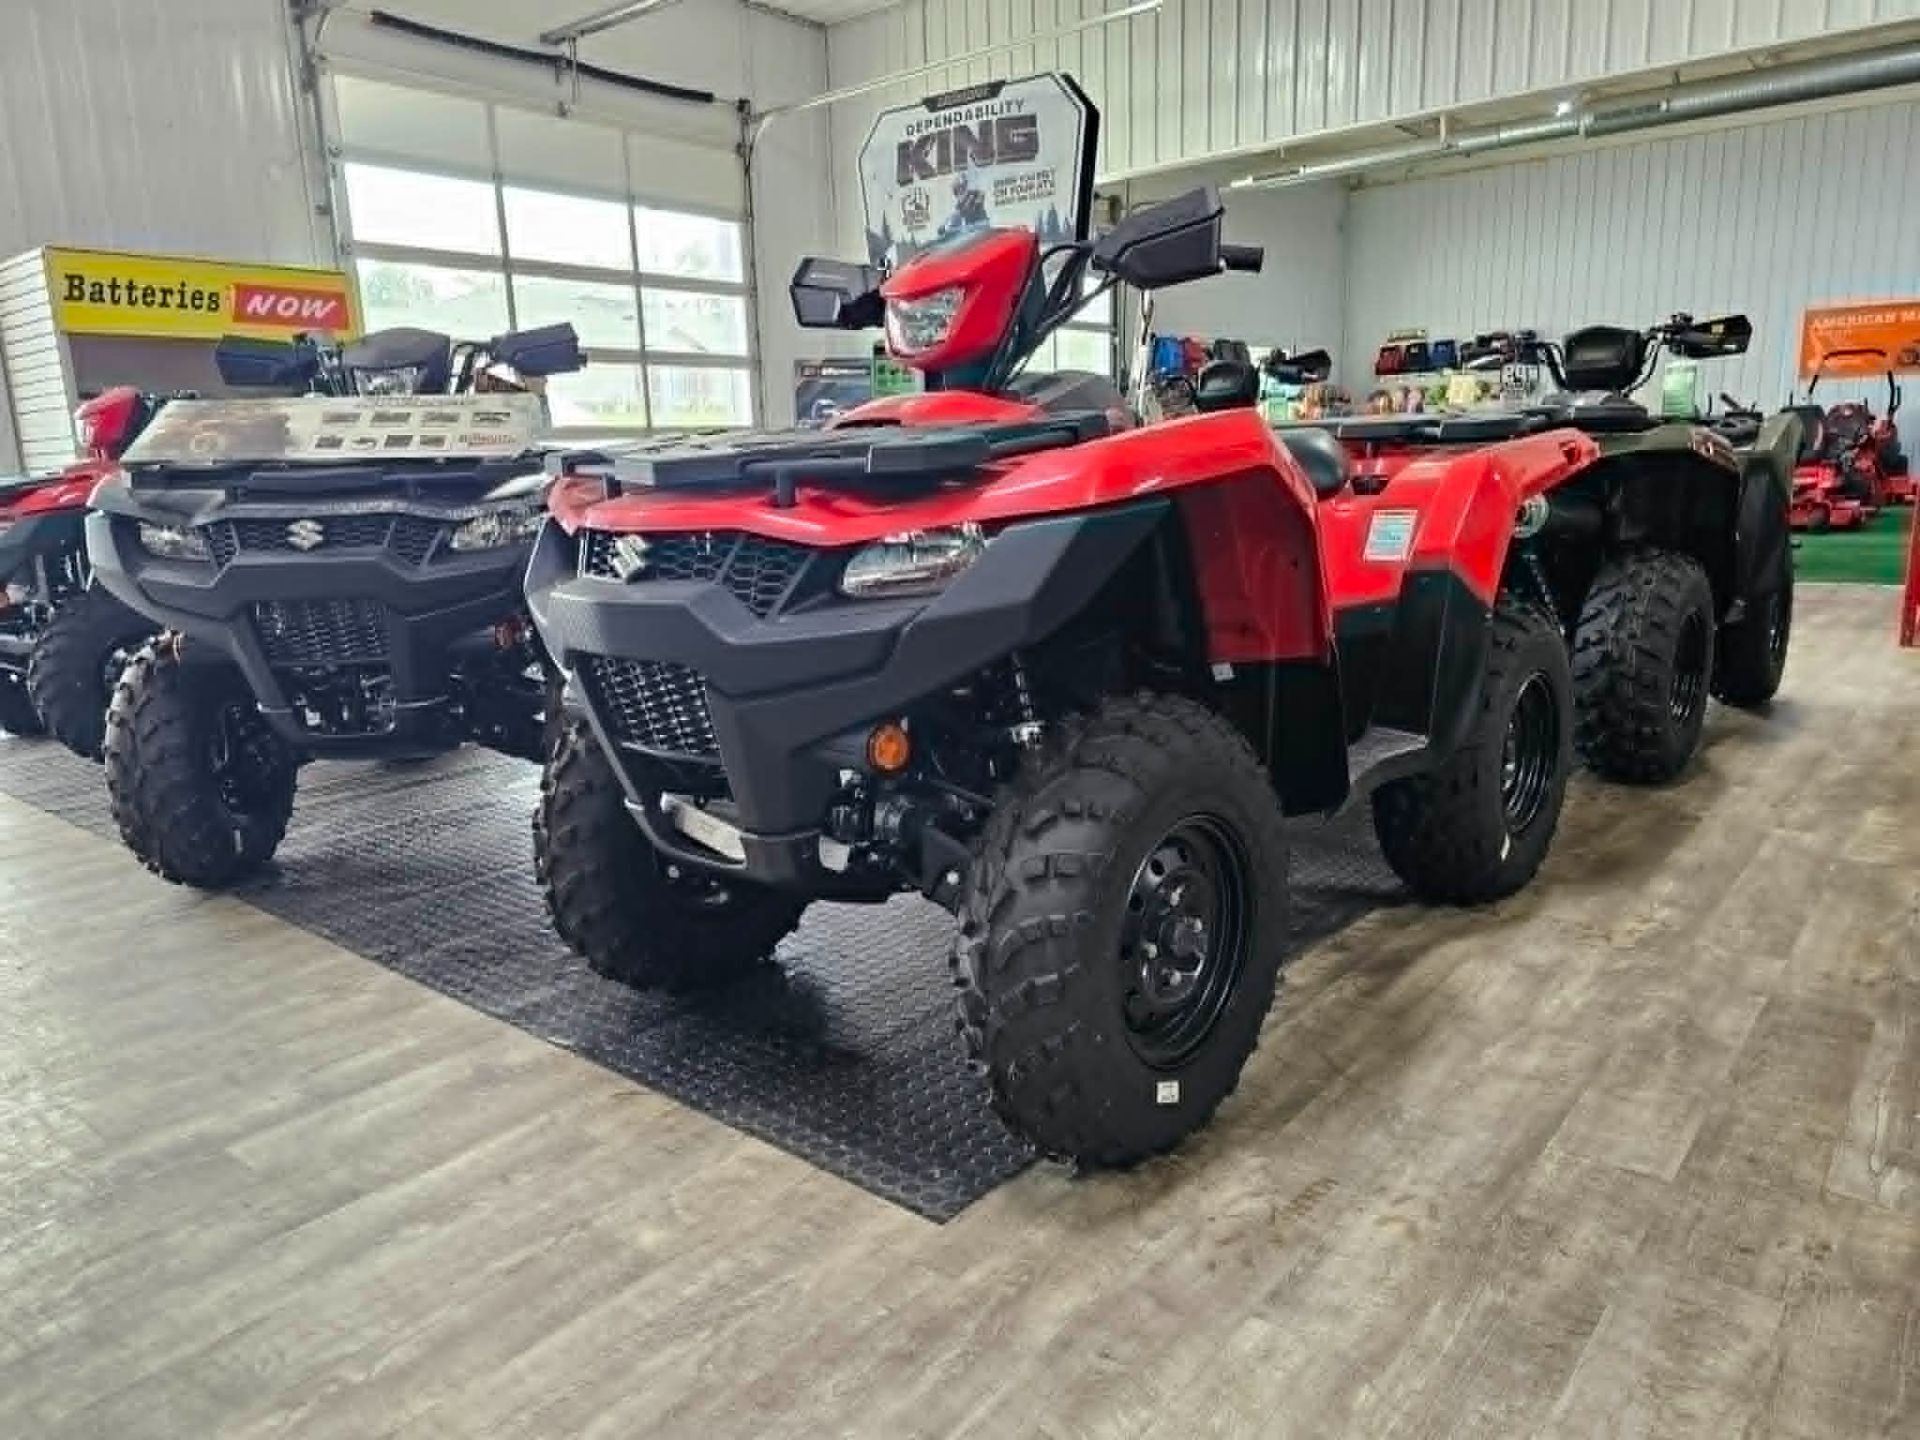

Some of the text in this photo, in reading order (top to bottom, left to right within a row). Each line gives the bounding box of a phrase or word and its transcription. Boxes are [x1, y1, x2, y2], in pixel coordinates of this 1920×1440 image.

[906, 100, 1024, 136] DEPENDABILITY
[897, 114, 1038, 185] KING
[63, 273, 338, 319] Batteries NOW
[1808, 313, 1896, 328] AMERICAN
